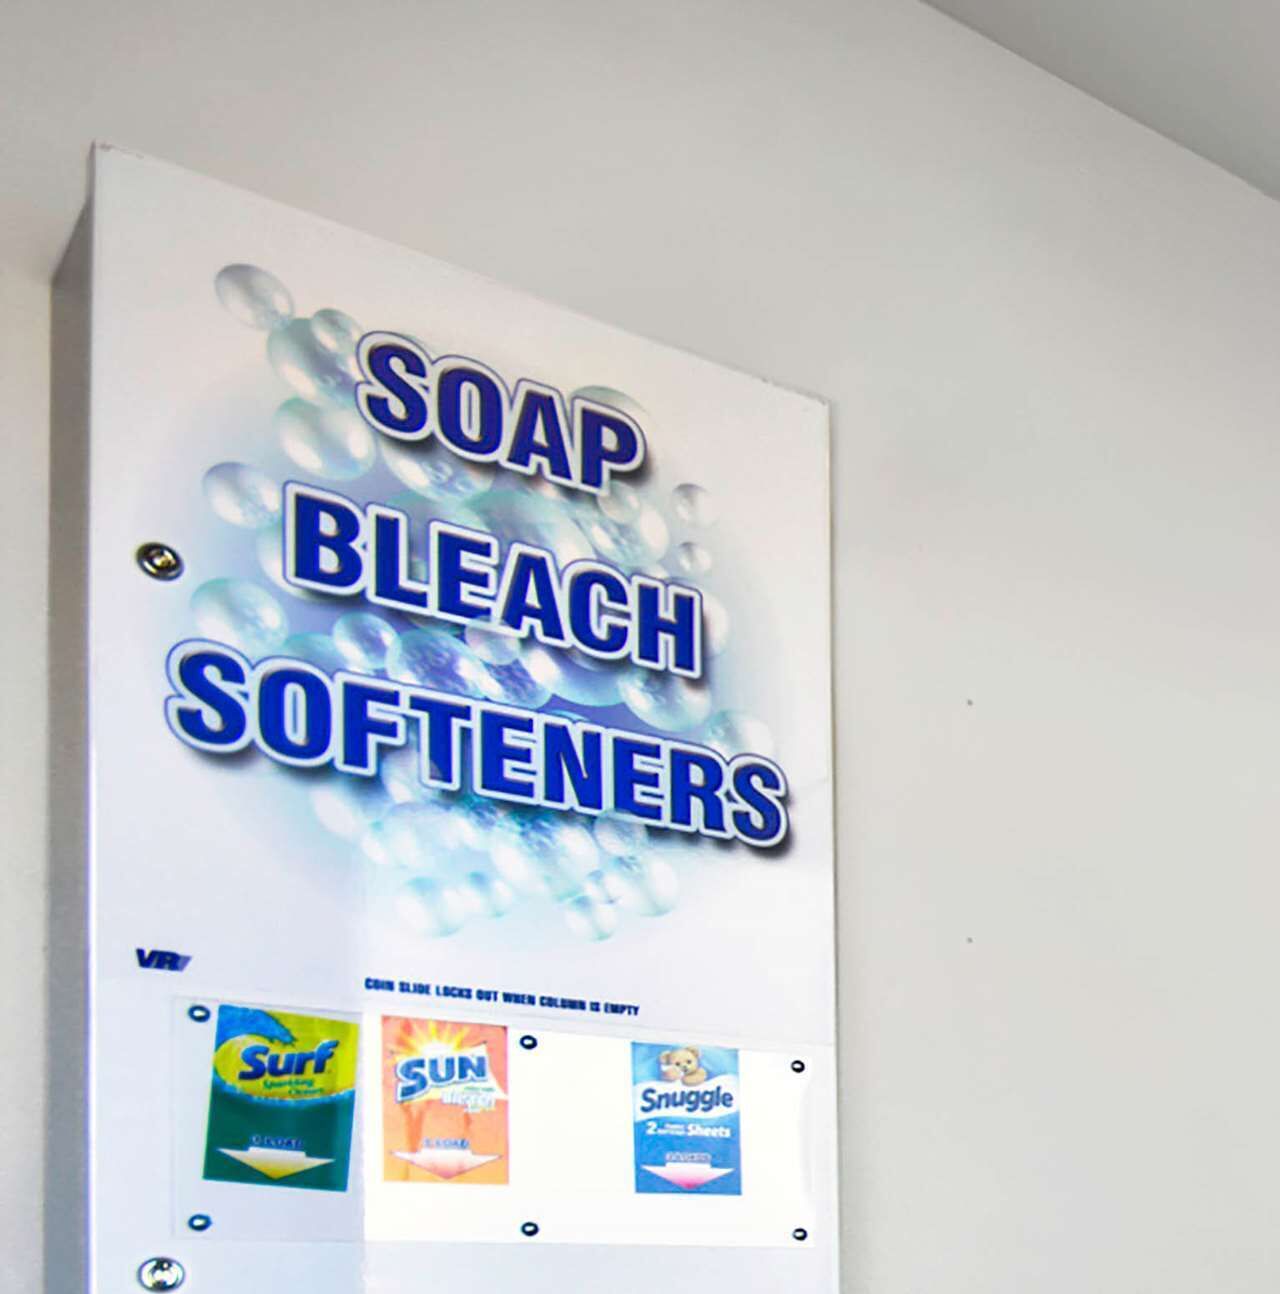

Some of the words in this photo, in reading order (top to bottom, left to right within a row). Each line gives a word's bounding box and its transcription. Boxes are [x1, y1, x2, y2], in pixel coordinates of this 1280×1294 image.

[356, 333, 648, 493] SOAP
[282, 480, 705, 679] BLEACH
[165, 638, 788, 847] SOFTENERS
[365, 977, 395, 992] COIN
[398, 981, 431, 996] SLIDE
[436, 985, 473, 1000] LOCKS
[476, 988, 499, 1002] OUT
[503, 991, 537, 1006] WHEN
[539, 995, 587, 1012] COLUMN
[589, 1000, 601, 1013] IS
[603, 1001, 641, 1017] EMPTY
[238, 1040, 340, 1081] Surf
[396, 1053, 488, 1102] SUN
[640, 1085, 734, 1113] Snuggle
[646, 1120, 658, 1136] 2
[687, 1122, 732, 1138] Sheets
